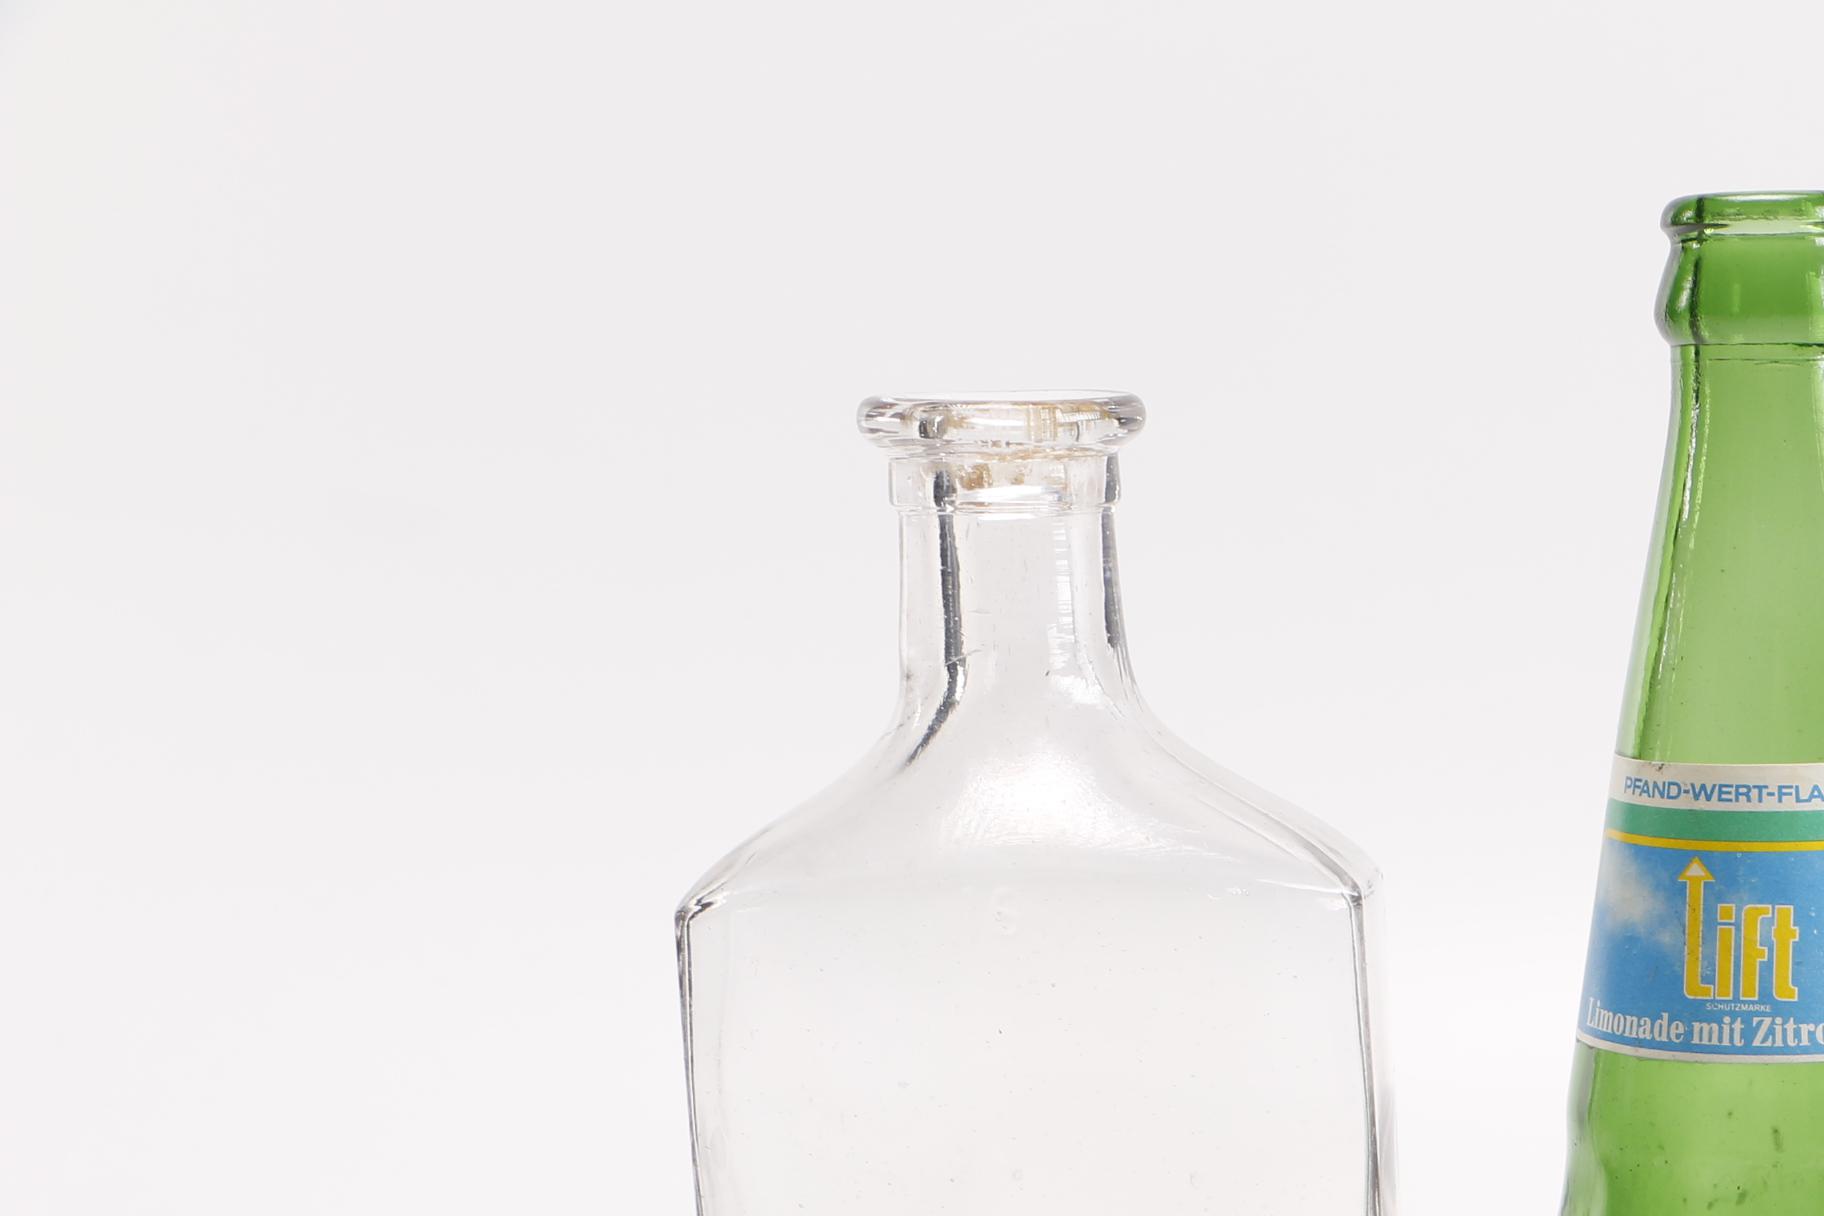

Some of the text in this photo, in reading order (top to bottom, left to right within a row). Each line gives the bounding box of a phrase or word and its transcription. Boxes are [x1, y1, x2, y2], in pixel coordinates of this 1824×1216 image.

[1677, 856, 1799, 1002] Lift
[1586, 996, 1685, 1043] Limonade
[1690, 1014, 1746, 1047] mit
[1705, 1002, 1773, 1013] SCHUTZMARKE
